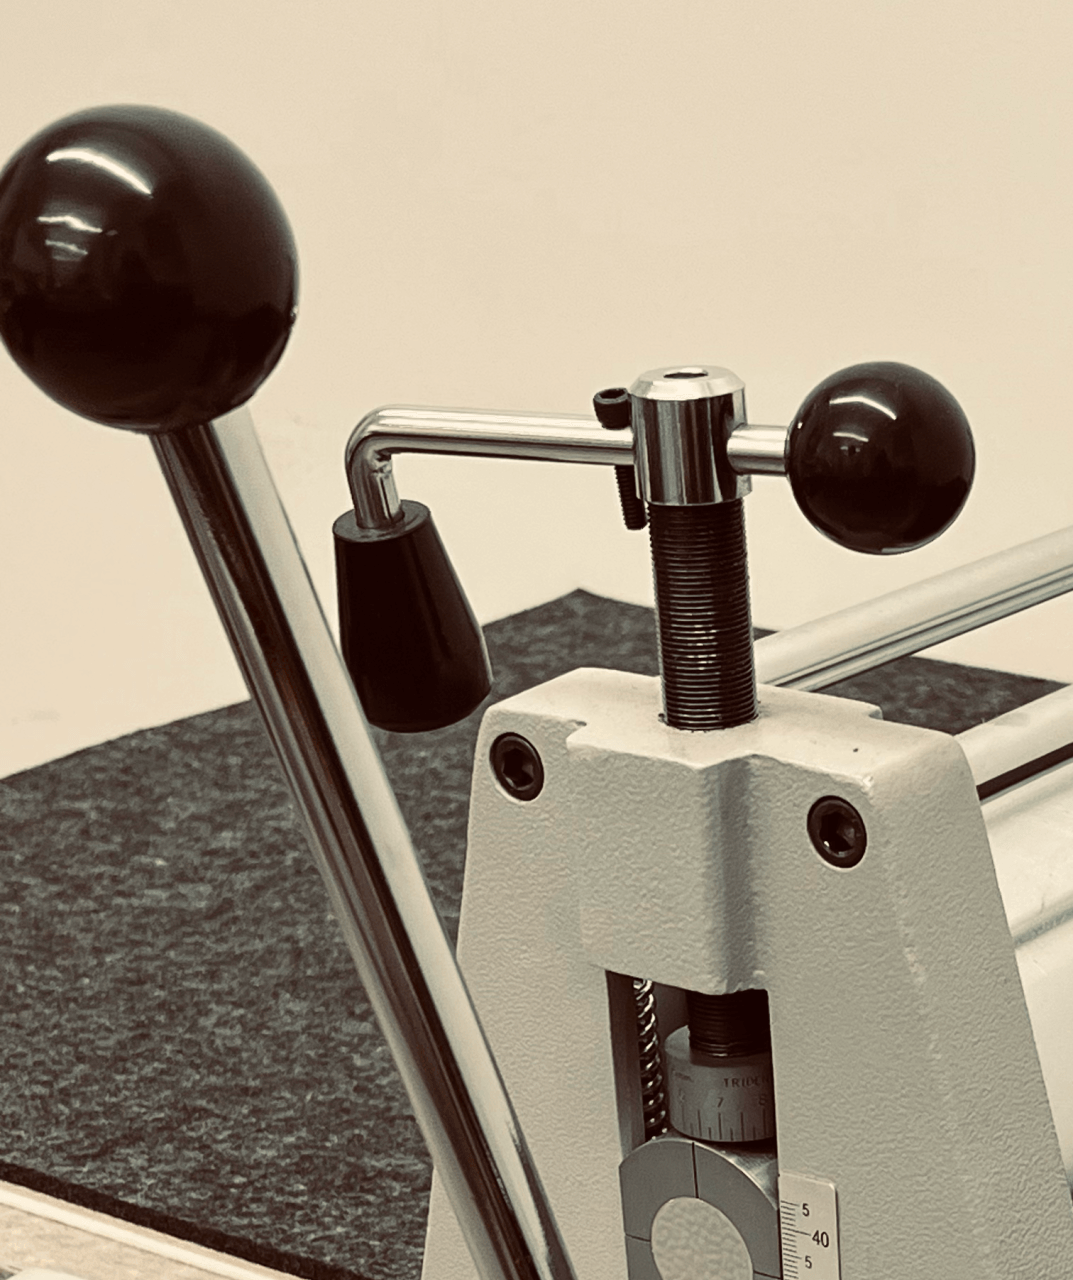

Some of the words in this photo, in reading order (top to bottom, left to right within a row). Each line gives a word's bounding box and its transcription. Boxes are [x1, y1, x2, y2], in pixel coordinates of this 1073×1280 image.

[717, 1097, 724, 1108] 7
[802, 1203, 810, 1217] 5
[812, 1230, 830, 1248] 40
[805, 1255, 813, 1269] 5
